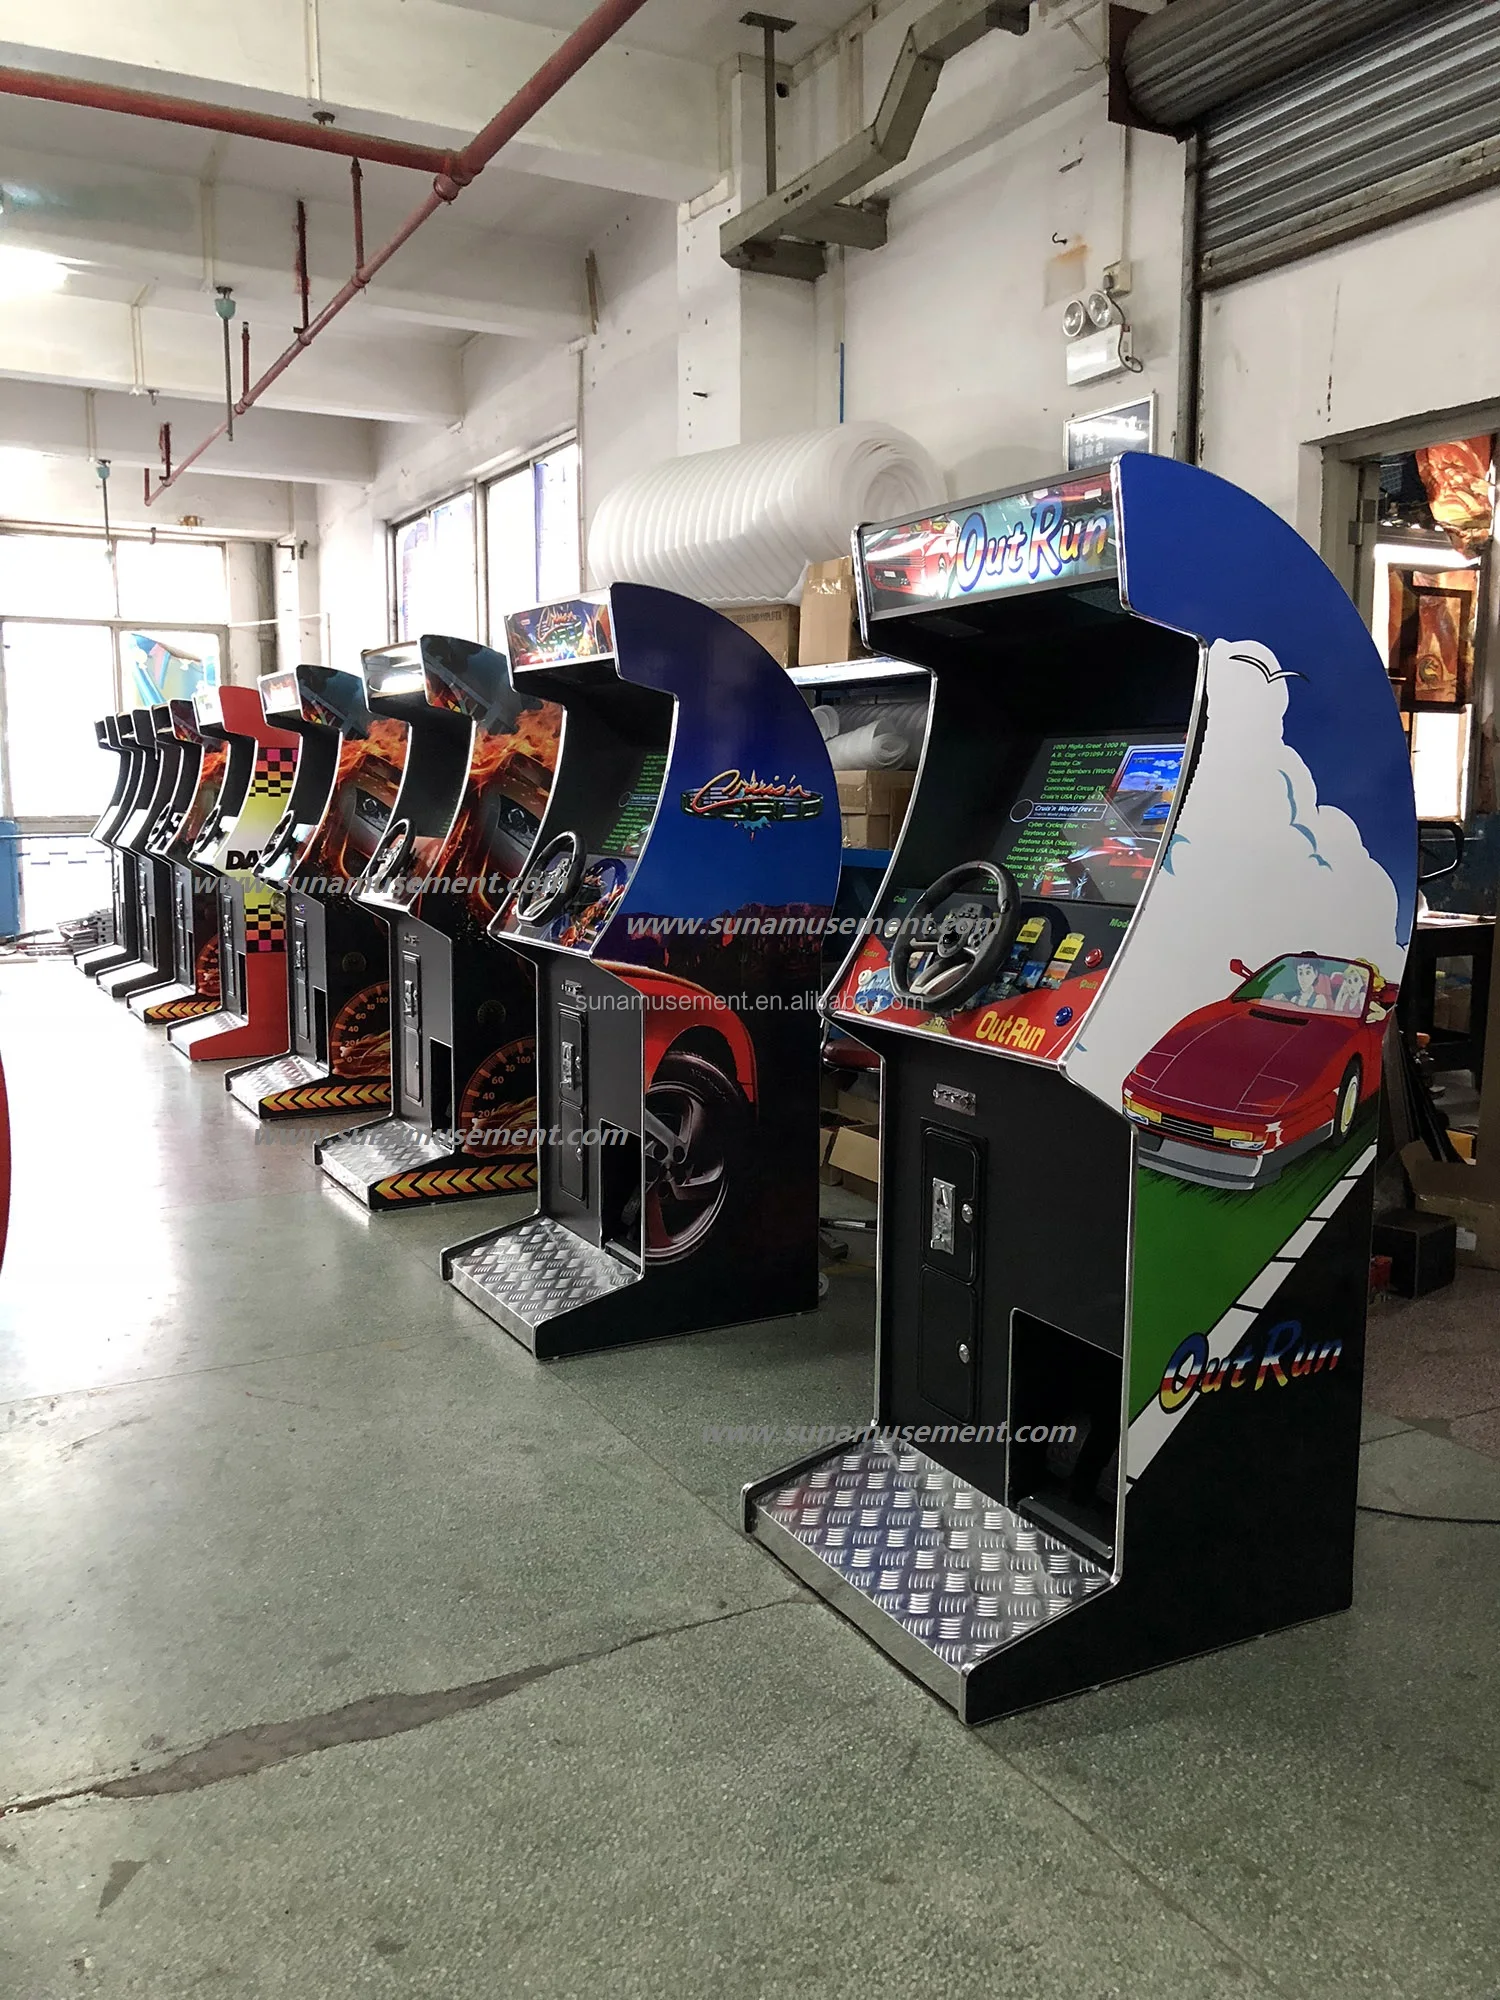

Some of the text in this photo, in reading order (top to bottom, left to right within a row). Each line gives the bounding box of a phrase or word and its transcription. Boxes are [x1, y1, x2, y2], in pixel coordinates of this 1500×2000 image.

[691, 769, 811, 813] Cruis'n
[225, 850, 263, 870] DA
[975, 1010, 1047, 1051] OutRun
